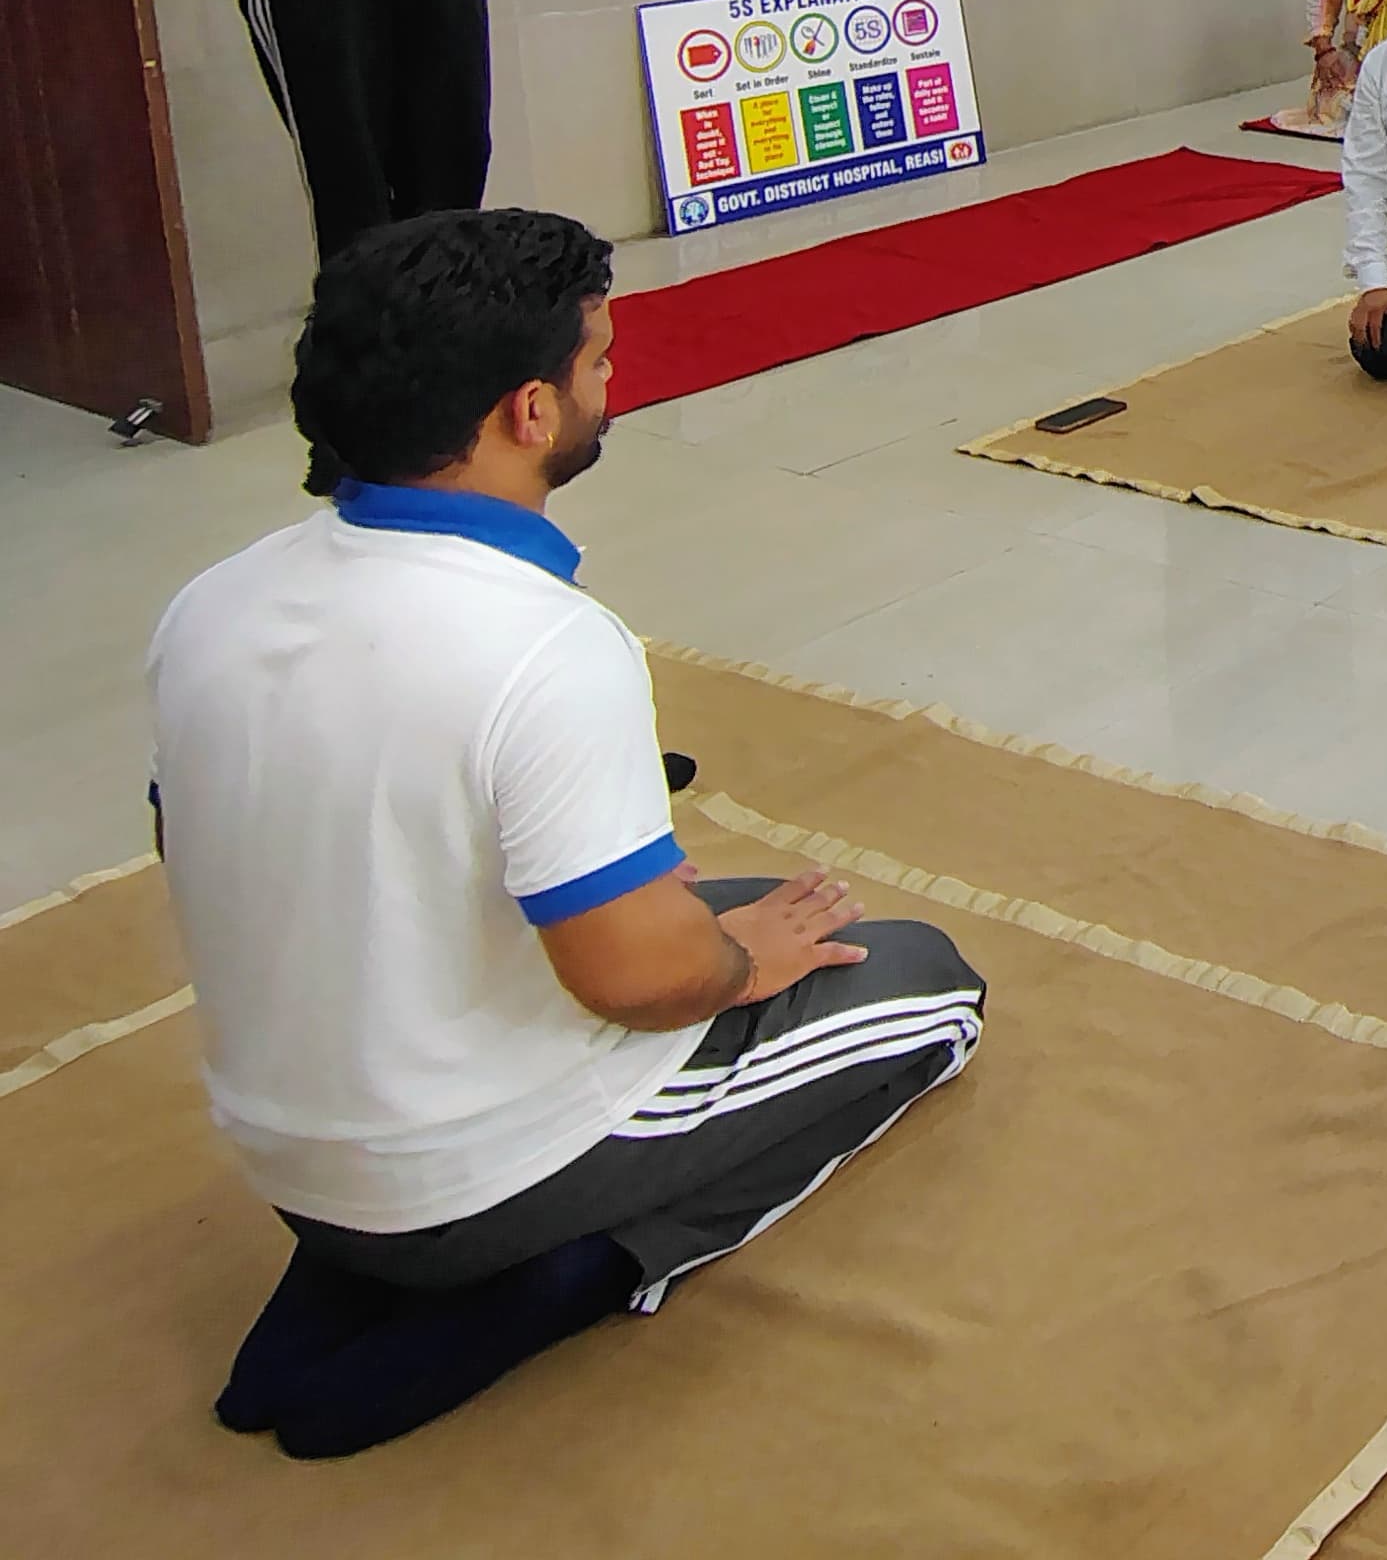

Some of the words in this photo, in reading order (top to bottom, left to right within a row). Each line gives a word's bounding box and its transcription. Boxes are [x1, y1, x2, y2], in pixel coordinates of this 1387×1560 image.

[854, 19, 882, 40] 5S
[911, 48, 941, 61] Sustain
[849, 56, 898, 72] Standardize
[808, 68, 831, 80] Shine
[736, 81, 751, 92] Set
[753, 79, 762, 89] in
[764, 75, 789, 87] Order
[693, 88, 713, 100] Sort
[718, 192, 761, 213] GOVT.
[765, 173, 830, 202] DISTRICT
[833, 159, 903, 187] HOSPITAL,
[905, 149, 943, 171] REASI
